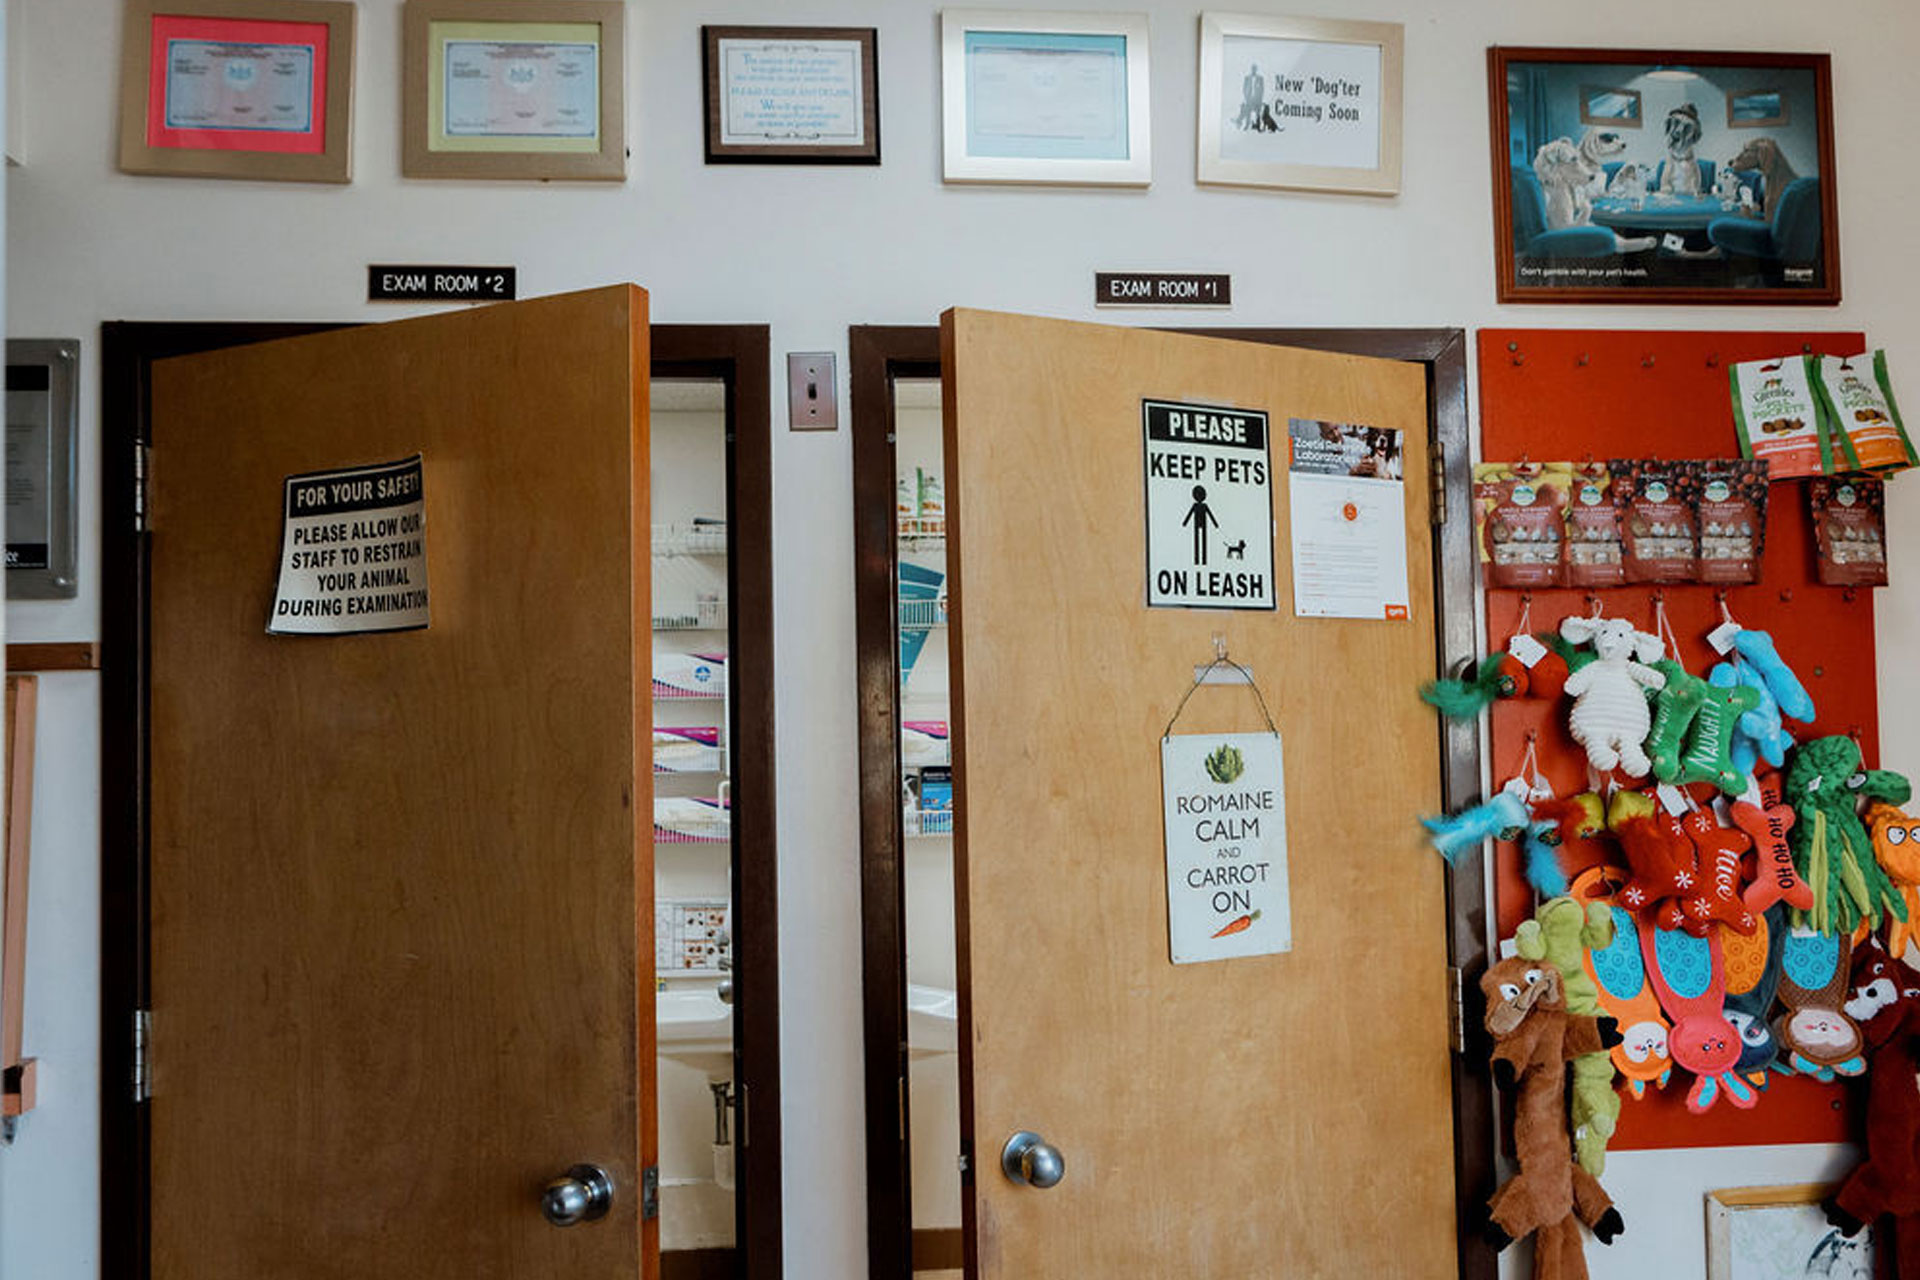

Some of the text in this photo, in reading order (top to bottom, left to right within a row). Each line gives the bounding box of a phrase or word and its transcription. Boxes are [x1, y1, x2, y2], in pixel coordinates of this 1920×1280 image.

[1275, 75, 1361, 98] New 'Dog'ter
[1275, 98, 1360, 122] Coming Soon
[383, 274, 426, 292] EXAM
[435, 275, 478, 292] ROOM
[1521, 267, 1541, 276] Don't
[1543, 268, 1569, 278] gamble
[1571, 268, 1587, 276] with
[1588, 269, 1604, 278] your
[1605, 268, 1622, 278] pet's
[1111, 280, 1151, 297] EXAM
[1158, 280, 1199, 297] ROOM
[1168, 411, 1247, 443] PLEASE
[1150, 452, 1265, 485] KEEP PETS
[297, 485, 327, 508] FOR
[331, 481, 373, 503] YOUR
[294, 514, 420, 545] PLEASE ALLOW OUR
[291, 540, 421, 569] STAFF TO RESTRAIN
[317, 567, 410, 592] YOUR ANIMAL
[1157, 570, 1264, 598] ON LEASH
[278, 589, 428, 617] DURING EXAMINATION
[1177, 791, 1273, 814] ROMAINE
[1195, 817, 1260, 842] CALM
[1217, 847, 1241, 859] AND
[1768, 817, 1795, 889] HO HO HO
[1187, 863, 1269, 889] CARROT
[1212, 890, 1250, 914] ON
